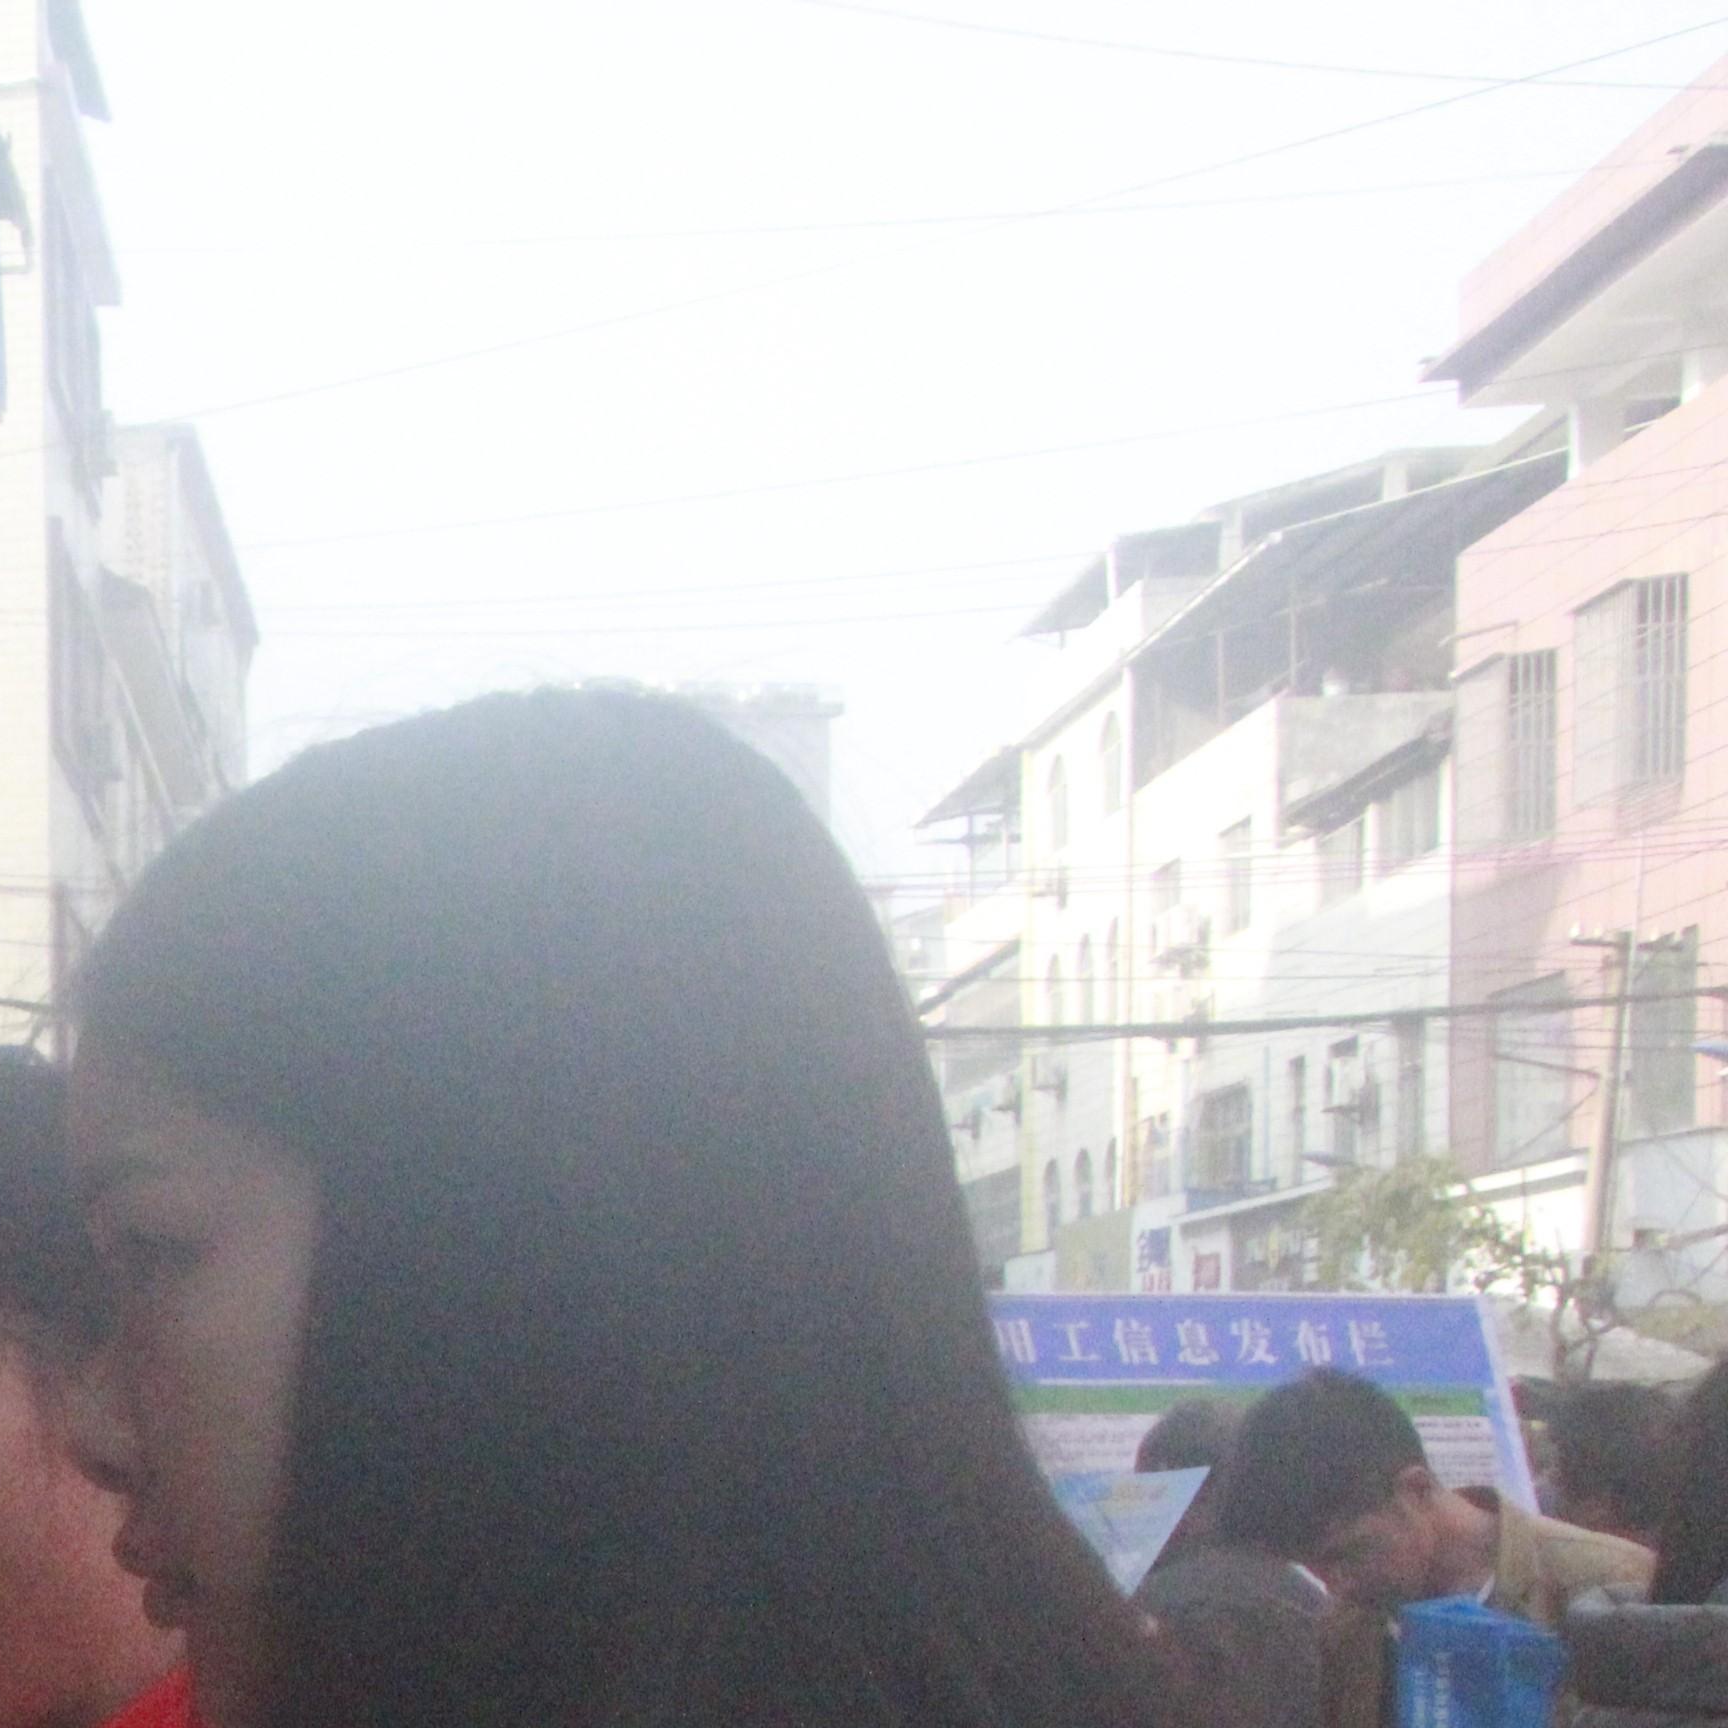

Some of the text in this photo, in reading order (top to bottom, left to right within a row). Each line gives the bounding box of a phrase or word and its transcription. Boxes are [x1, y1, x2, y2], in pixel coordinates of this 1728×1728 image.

[997, 1317, 1396, 1367] 用工信息发布栏
